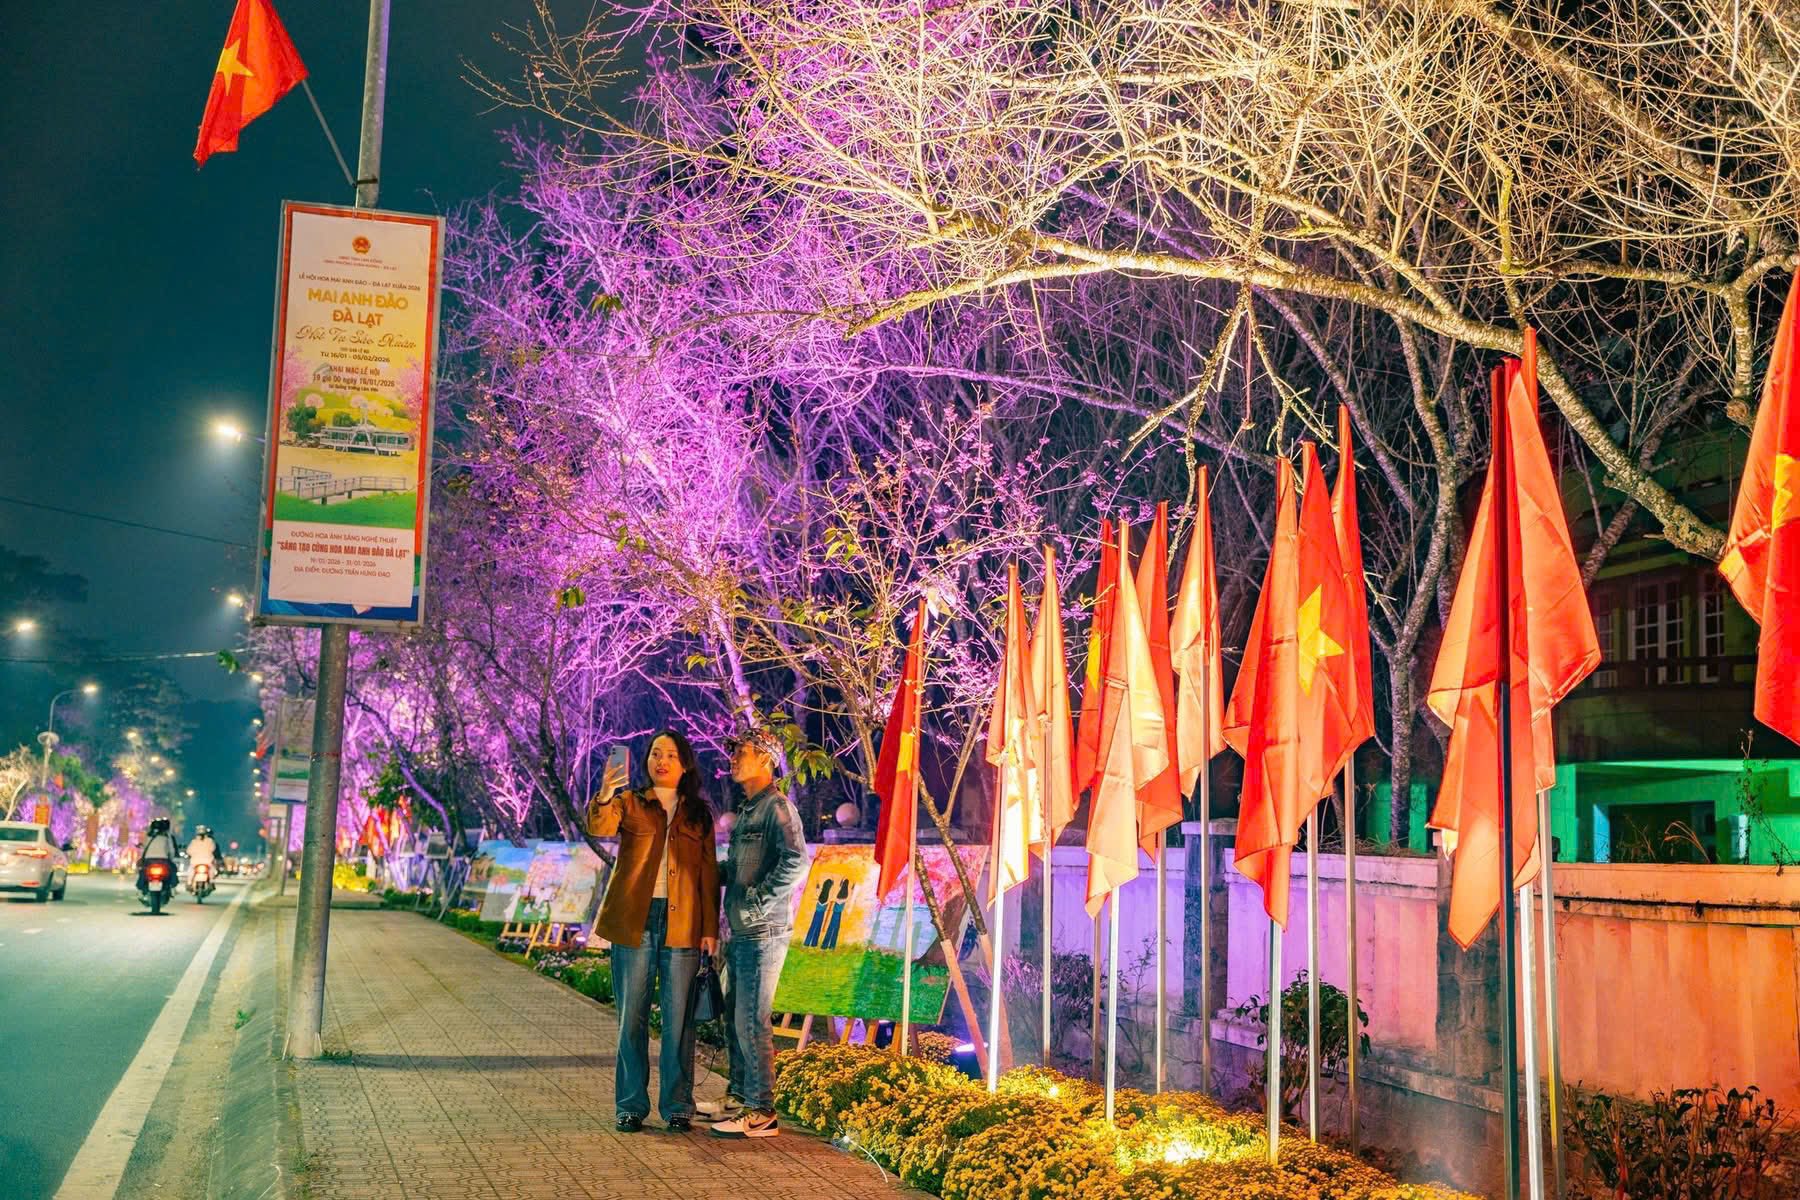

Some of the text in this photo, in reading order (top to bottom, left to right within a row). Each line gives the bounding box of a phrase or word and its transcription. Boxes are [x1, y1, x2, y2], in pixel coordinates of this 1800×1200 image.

[308, 288, 408, 309] MAI ANH ĐÀO
[332, 307, 383, 328] ĐÀ LẠT
[361, 366, 368, 374] LỄ
[370, 368, 380, 376] HỘI
[343, 377, 357, 385] ngày
[298, 543, 310, 553] TẠO
[312, 542, 328, 553] CÙNG
[329, 544, 342, 553] HOA
[344, 545, 356, 554] MAI
[358, 546, 370, 556] ANH
[322, 567, 343, 575] ĐƯỜNG
